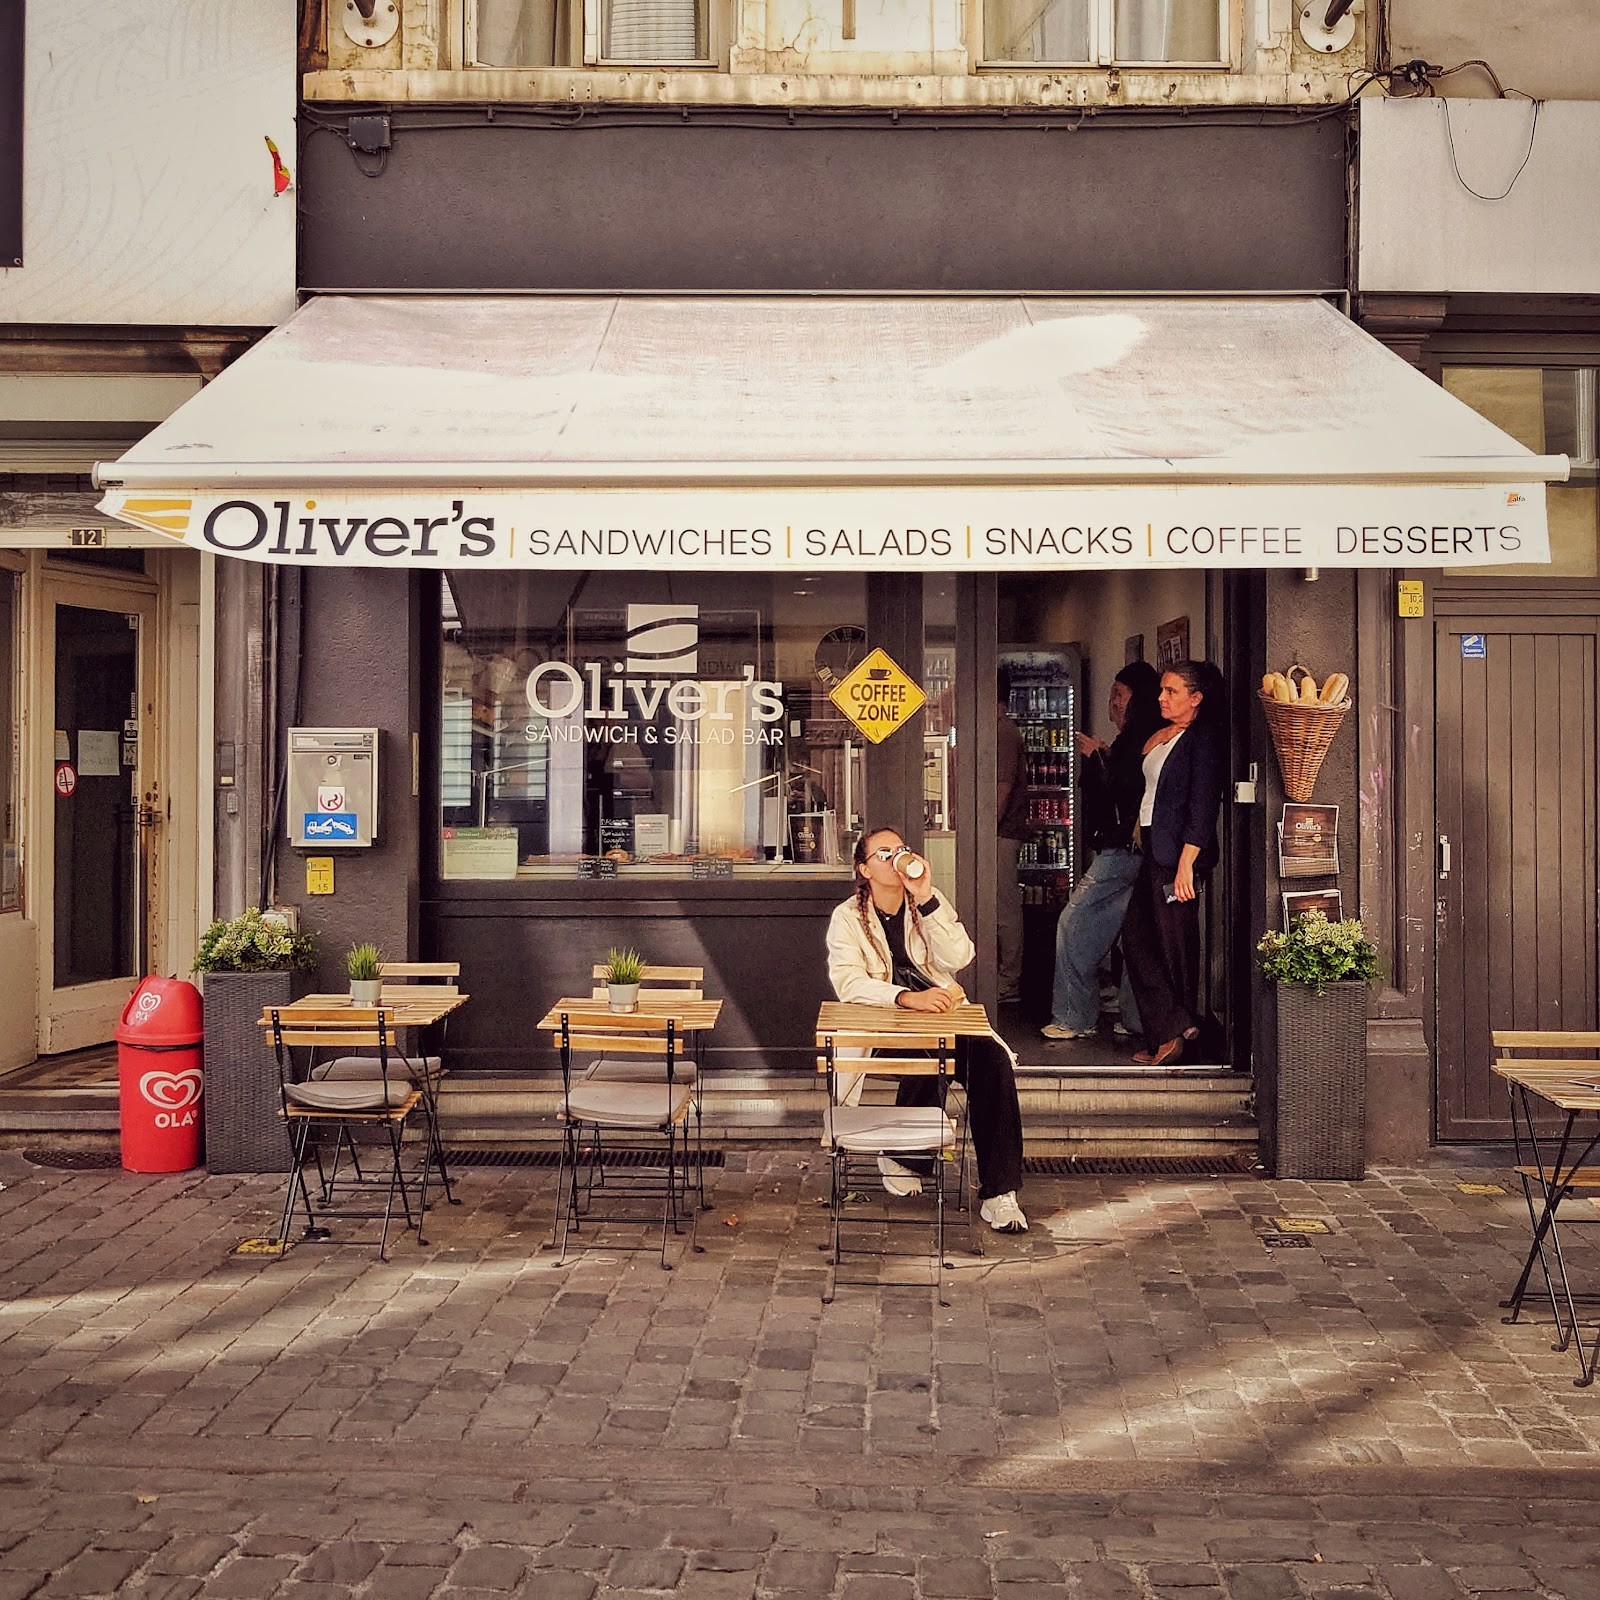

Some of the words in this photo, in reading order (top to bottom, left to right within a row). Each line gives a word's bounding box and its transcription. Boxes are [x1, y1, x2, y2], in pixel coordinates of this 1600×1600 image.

[78, 530, 97, 545] 12
[203, 500, 496, 557] Oliver's
[529, 528, 772, 555] SANDWICHES
[805, 528, 952, 555] SALADS
[985, 526, 1133, 555] SNACKS
[1166, 526, 1302, 554] COFFEE
[1336, 525, 1522, 554] DESSERTS
[525, 661, 785, 723] Oliver's
[850, 683, 906, 702] COFFEE
[857, 704, 900, 722] ZONE
[525, 724, 638, 744] SANDWICH
[644, 725, 659, 745] &
[664, 726, 735, 746] SALAD
[743, 727, 785, 747] BAR
